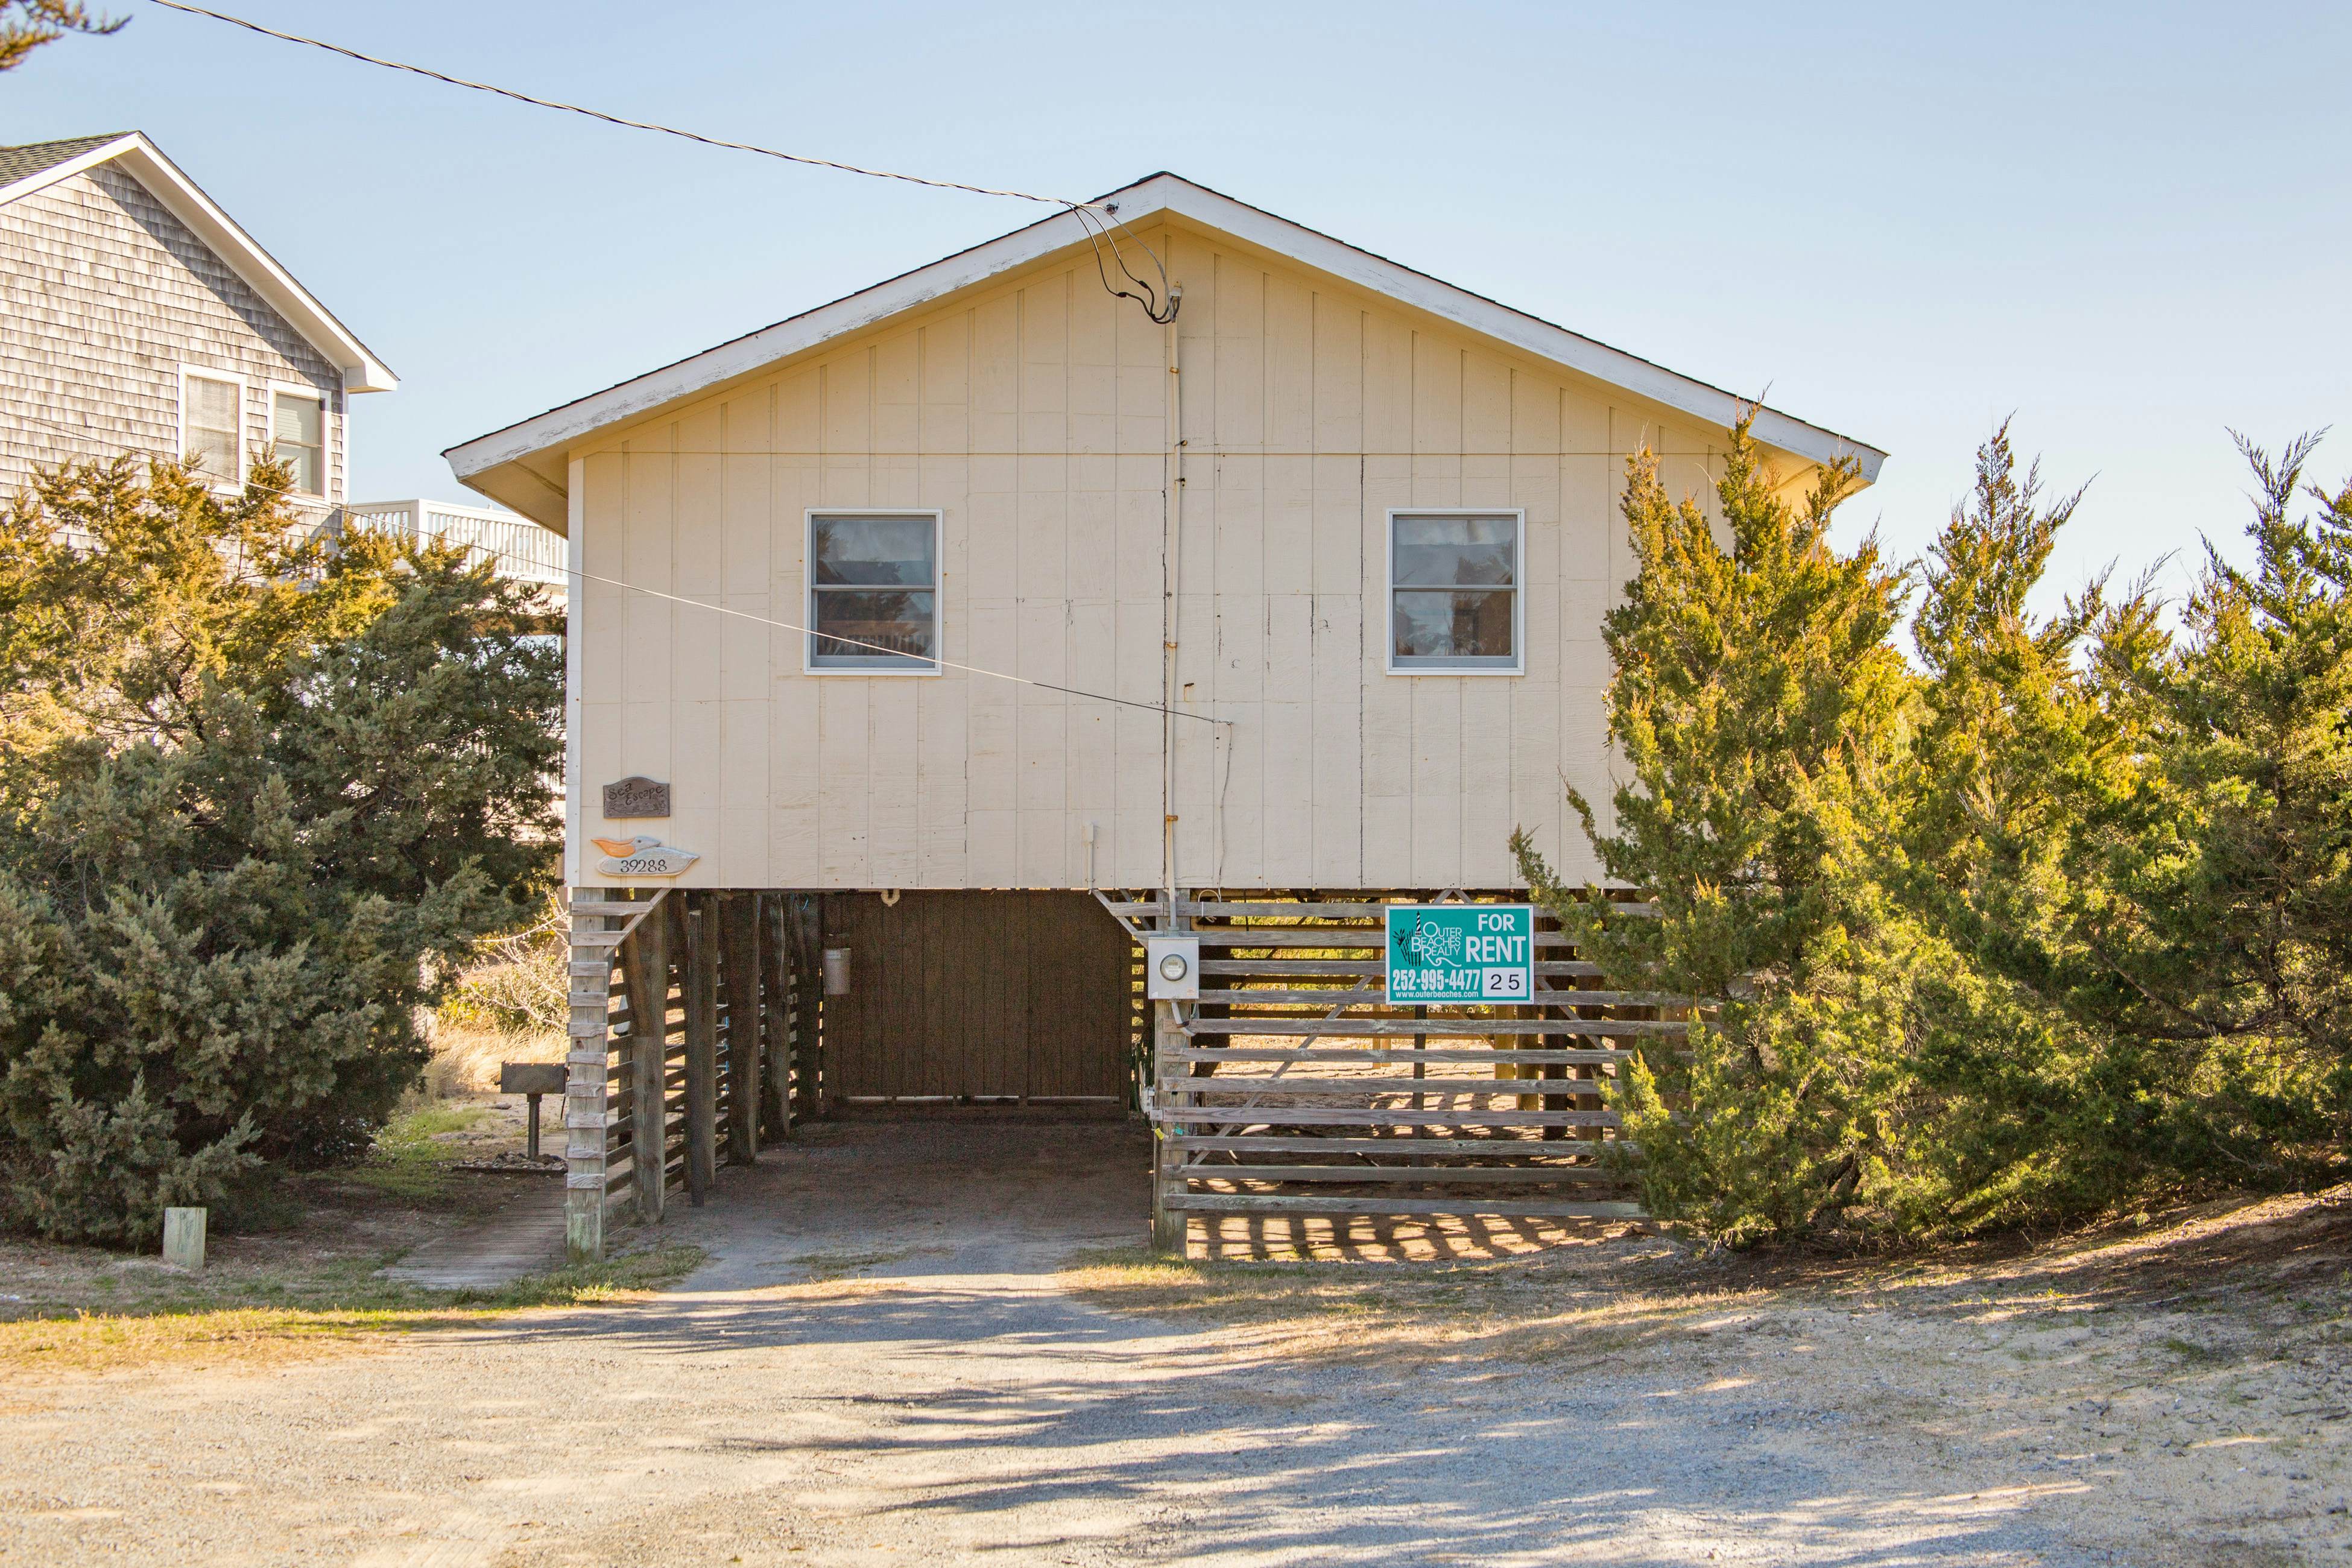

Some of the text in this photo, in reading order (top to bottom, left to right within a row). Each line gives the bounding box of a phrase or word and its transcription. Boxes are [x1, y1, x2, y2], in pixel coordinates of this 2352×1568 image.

[608, 783, 632, 800] Sea
[621, 859, 667, 873] 39288
[1478, 914, 1516, 931] FOR
[1465, 936, 1526, 963] RENT
[1393, 969, 1481, 991] 252-995-4477
